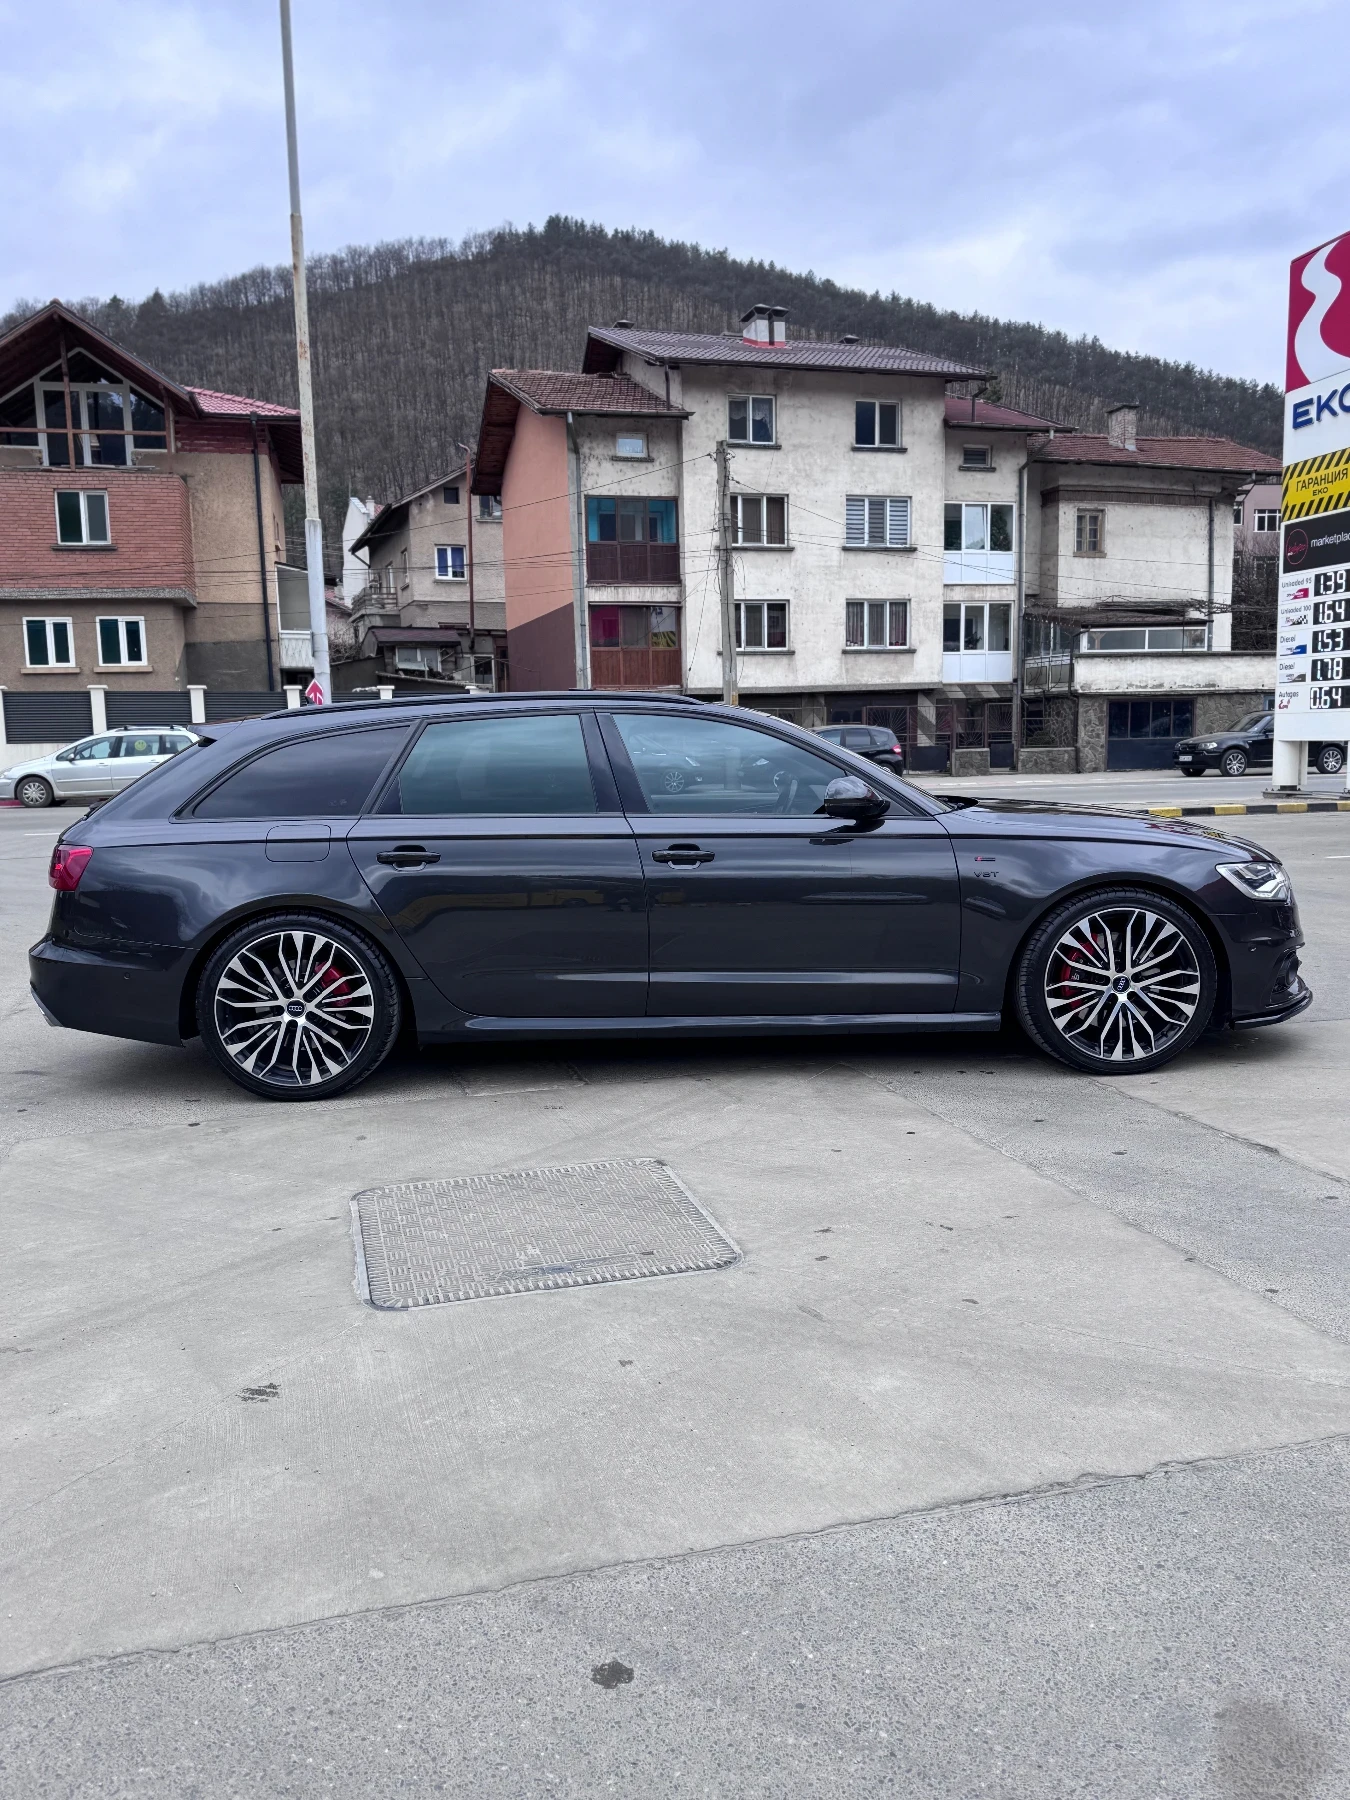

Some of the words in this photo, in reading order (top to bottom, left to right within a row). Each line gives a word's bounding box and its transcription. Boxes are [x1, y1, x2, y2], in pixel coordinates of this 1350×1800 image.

[1296, 467, 1348, 492] ГАРАНЦИЯ
[1320, 570, 1346, 594] 1.39
[1280, 606, 1302, 614] Unleaded
[1319, 601, 1345, 623] 1.64
[1279, 634, 1296, 643] Diesel
[1317, 628, 1344, 652] 1.53
[1279, 662, 1296, 670] Diesel
[1316, 657, 1343, 681] 1.78
[1310, 687, 1342, 709] 0.64
